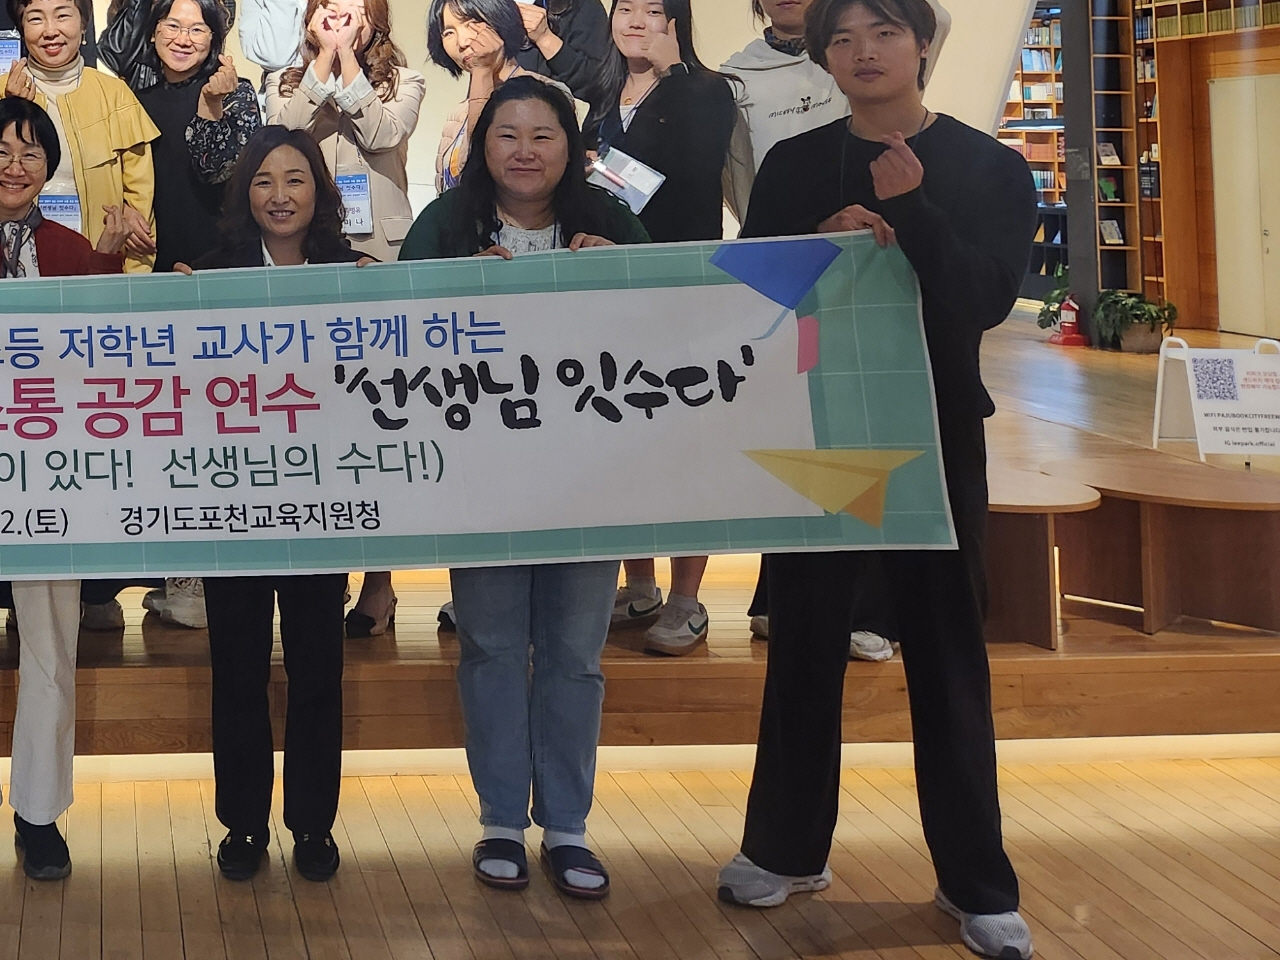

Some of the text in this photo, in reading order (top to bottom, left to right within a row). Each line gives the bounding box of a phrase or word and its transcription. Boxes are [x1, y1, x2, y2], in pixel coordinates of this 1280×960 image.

[58, 323, 177, 369] 저학년
[192, 319, 315, 365] 교사가
[325, 314, 409, 362] 함께
[422, 310, 507, 356] 하는
[76, 375, 191, 440] 공감
[205, 372, 321, 435] 연수
[44, 448, 134, 492] 있다!
[161, 443, 321, 489] 선생님의
[335, 439, 445, 485] 수다!)
[119, 500, 381, 536] 경기도포천교육지원청
